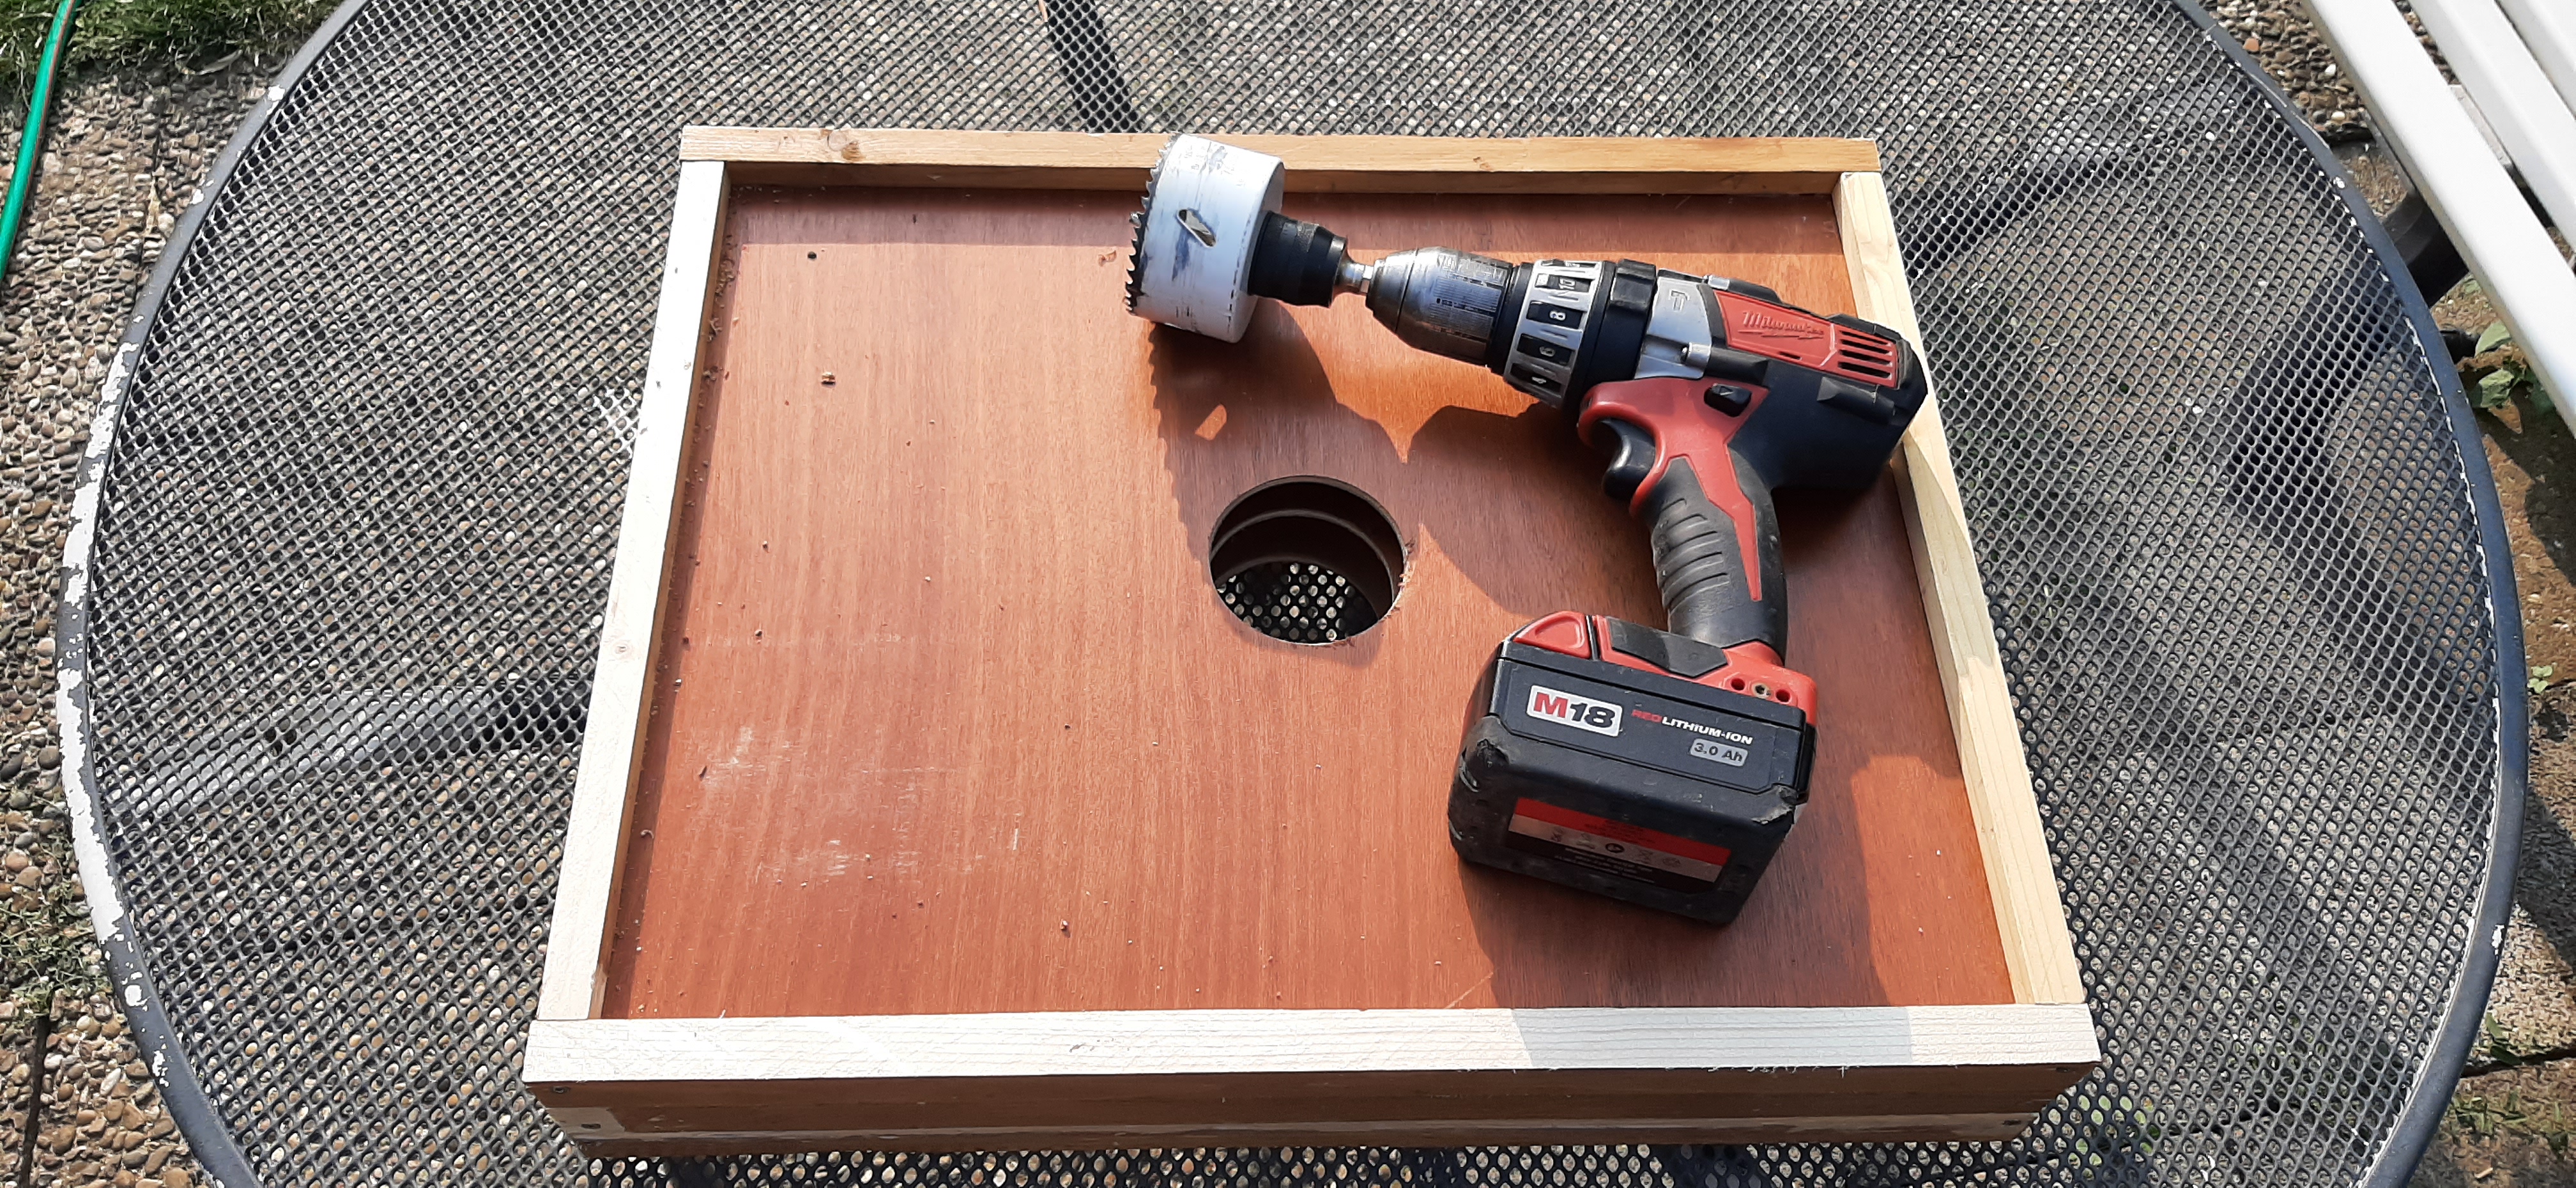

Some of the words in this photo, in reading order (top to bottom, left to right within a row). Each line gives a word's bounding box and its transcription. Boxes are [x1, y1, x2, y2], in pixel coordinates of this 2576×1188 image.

[1549, 310, 1566, 321] 8
[1539, 346, 1556, 357] 6
[1533, 692, 1615, 728] M18
[1694, 742, 1719, 756] 3.0
[1722, 750, 1743, 763] Ah
